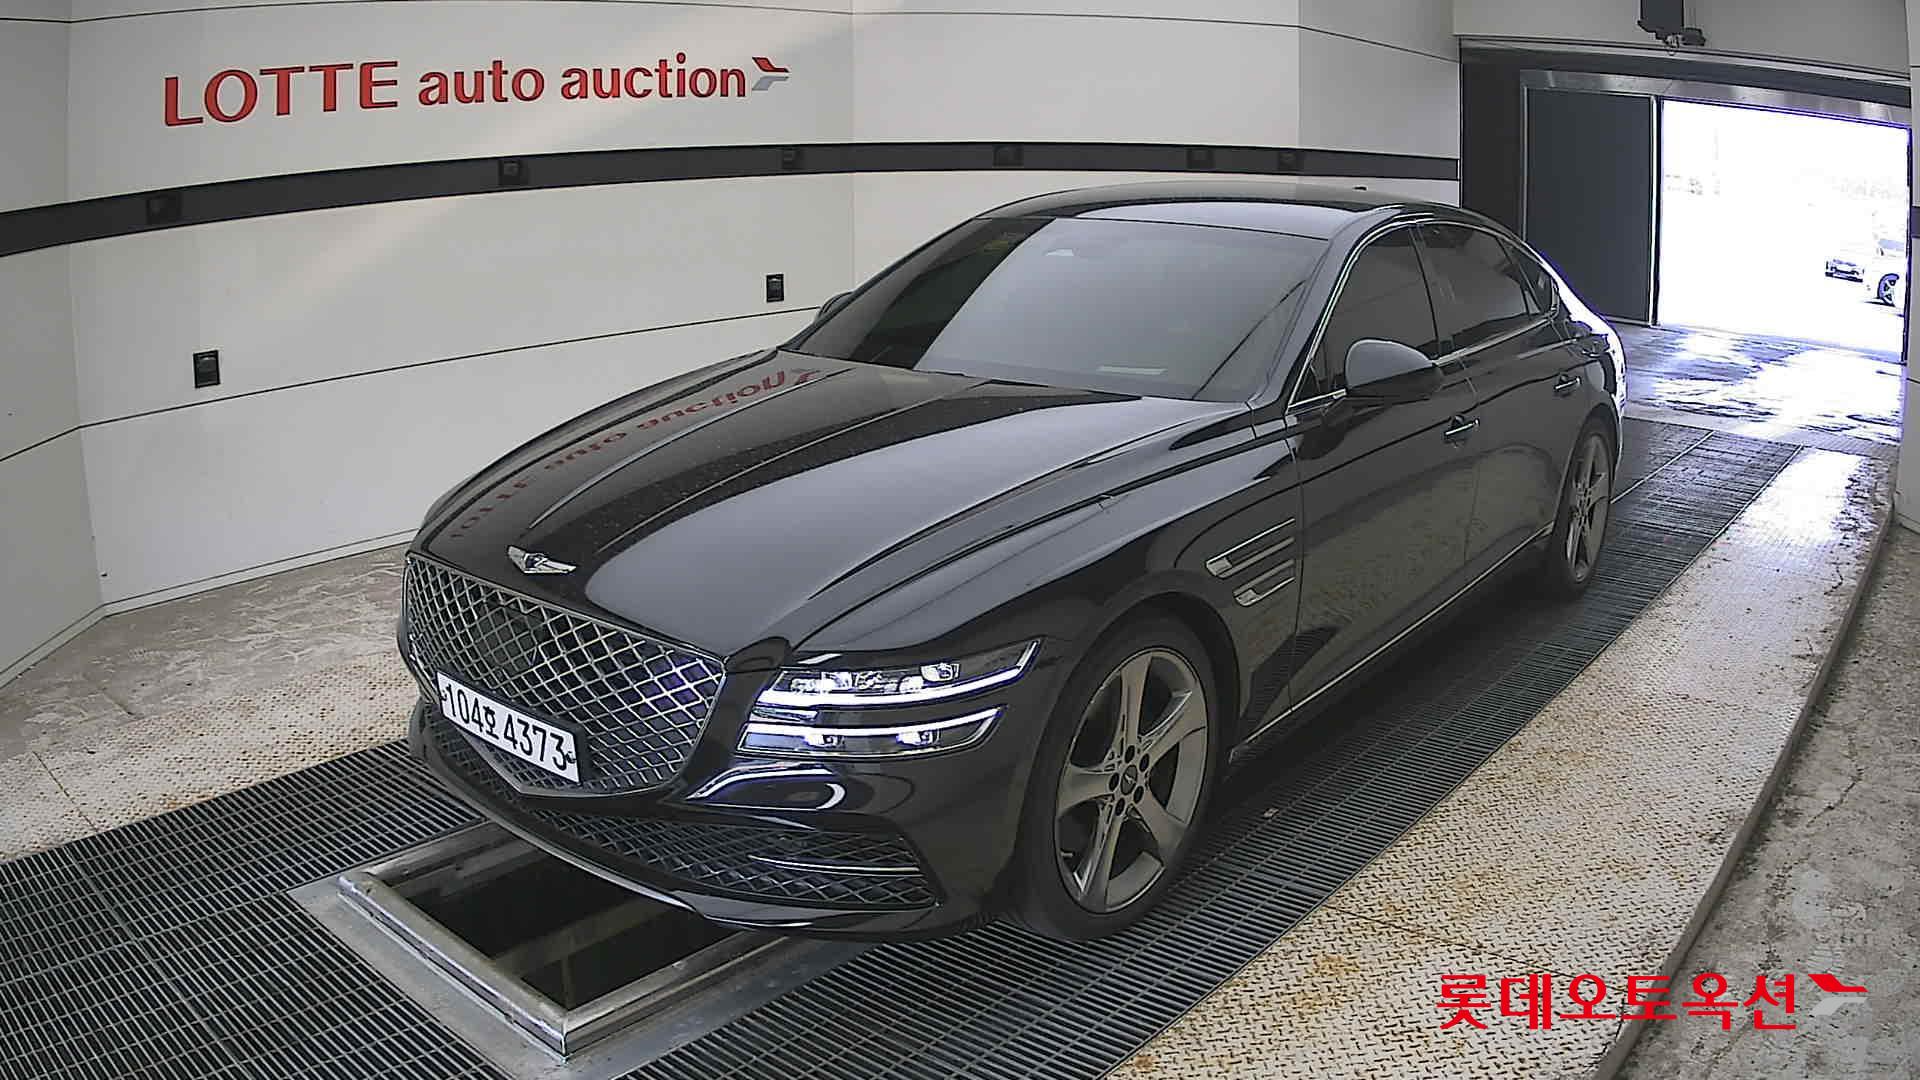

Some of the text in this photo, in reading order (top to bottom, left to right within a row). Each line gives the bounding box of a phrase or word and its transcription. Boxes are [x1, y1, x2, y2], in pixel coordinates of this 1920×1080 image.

[163, 52, 746, 127] LOTTE auto auction
[446, 683, 568, 771] 104호 4373
